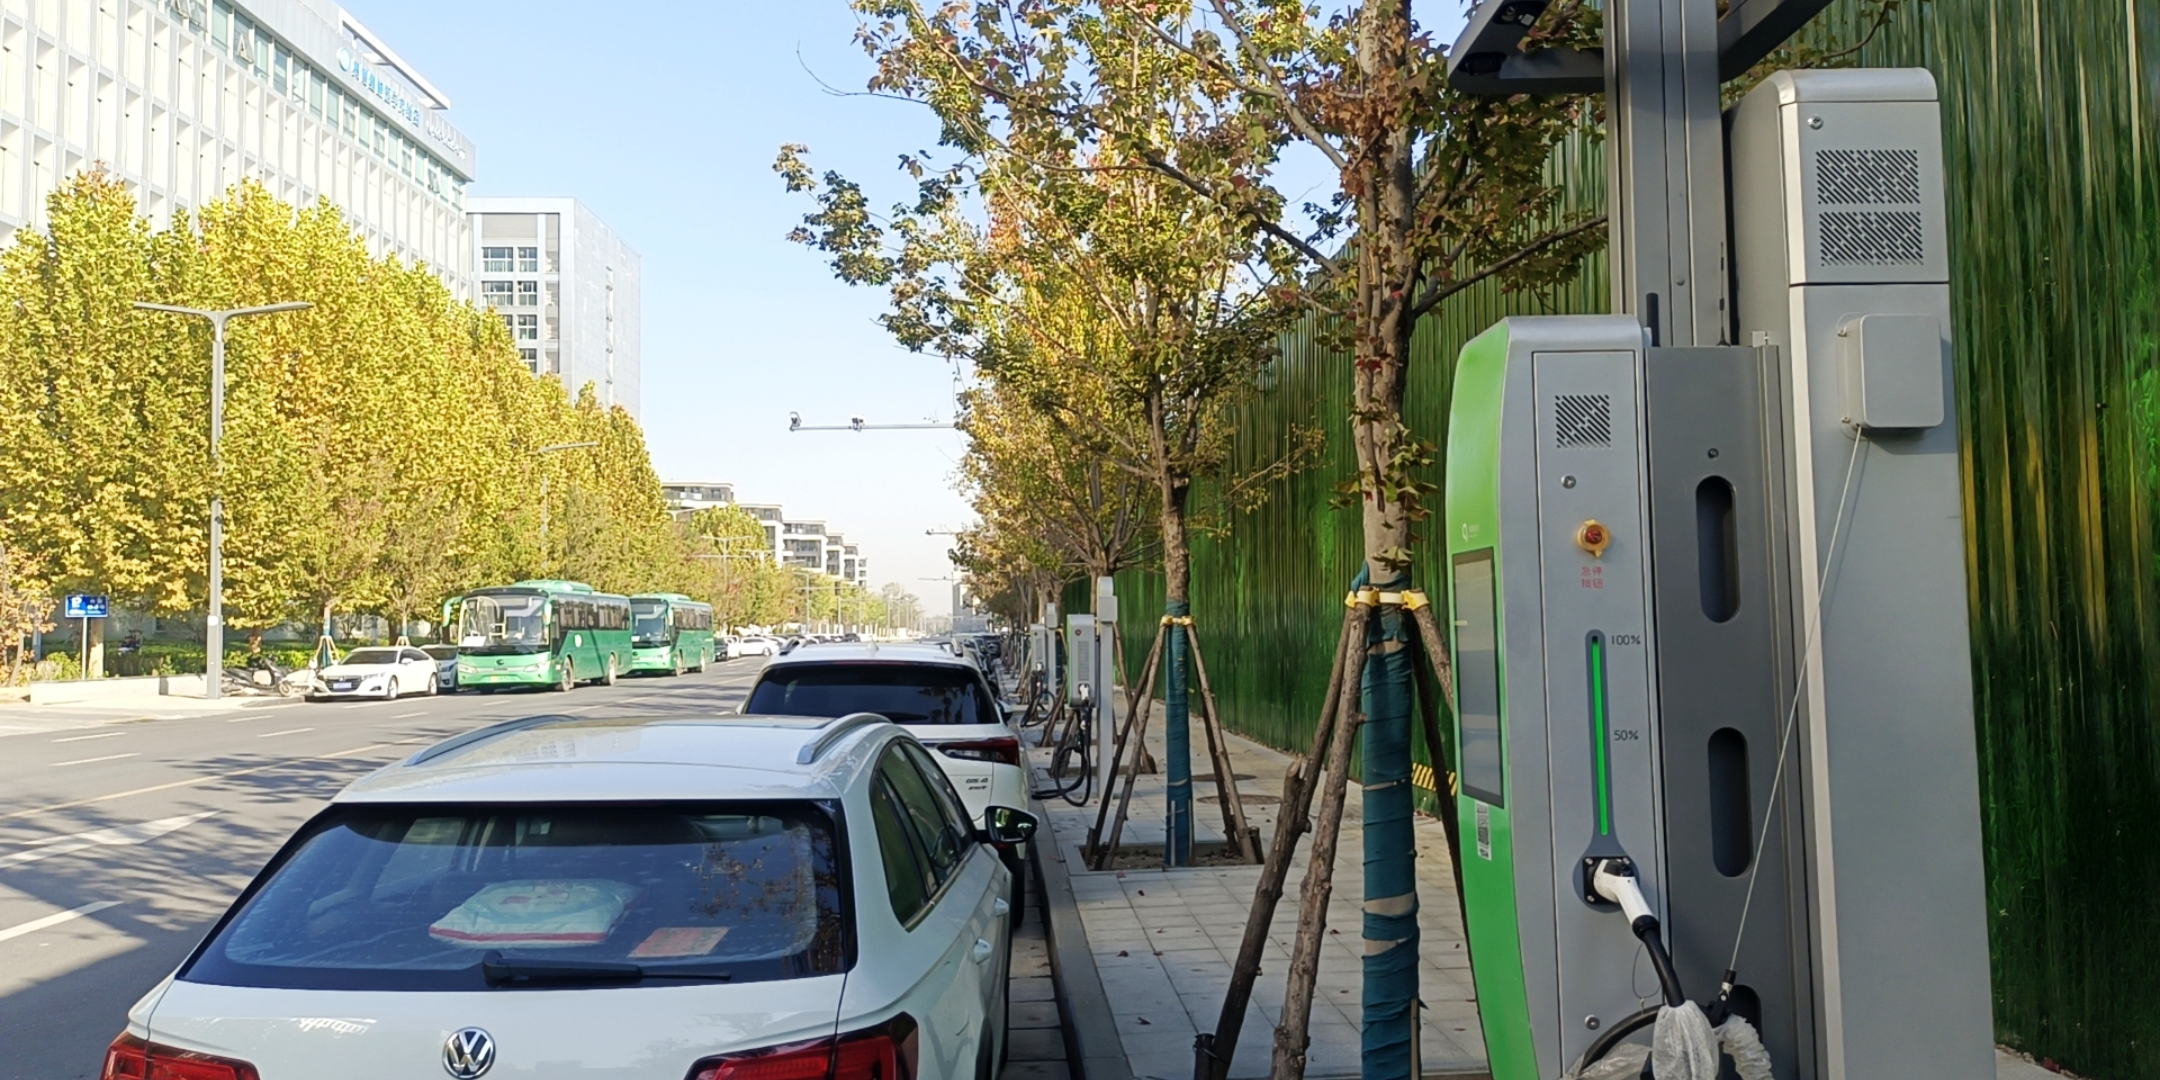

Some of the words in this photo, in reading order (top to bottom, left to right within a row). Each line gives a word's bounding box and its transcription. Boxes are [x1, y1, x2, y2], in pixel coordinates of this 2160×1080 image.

[1581, 566, 1603, 576] 急停
[1581, 578, 1604, 589] 按钮
[1611, 634, 1641, 645] 100%
[1614, 729, 1639, 741] 50%
